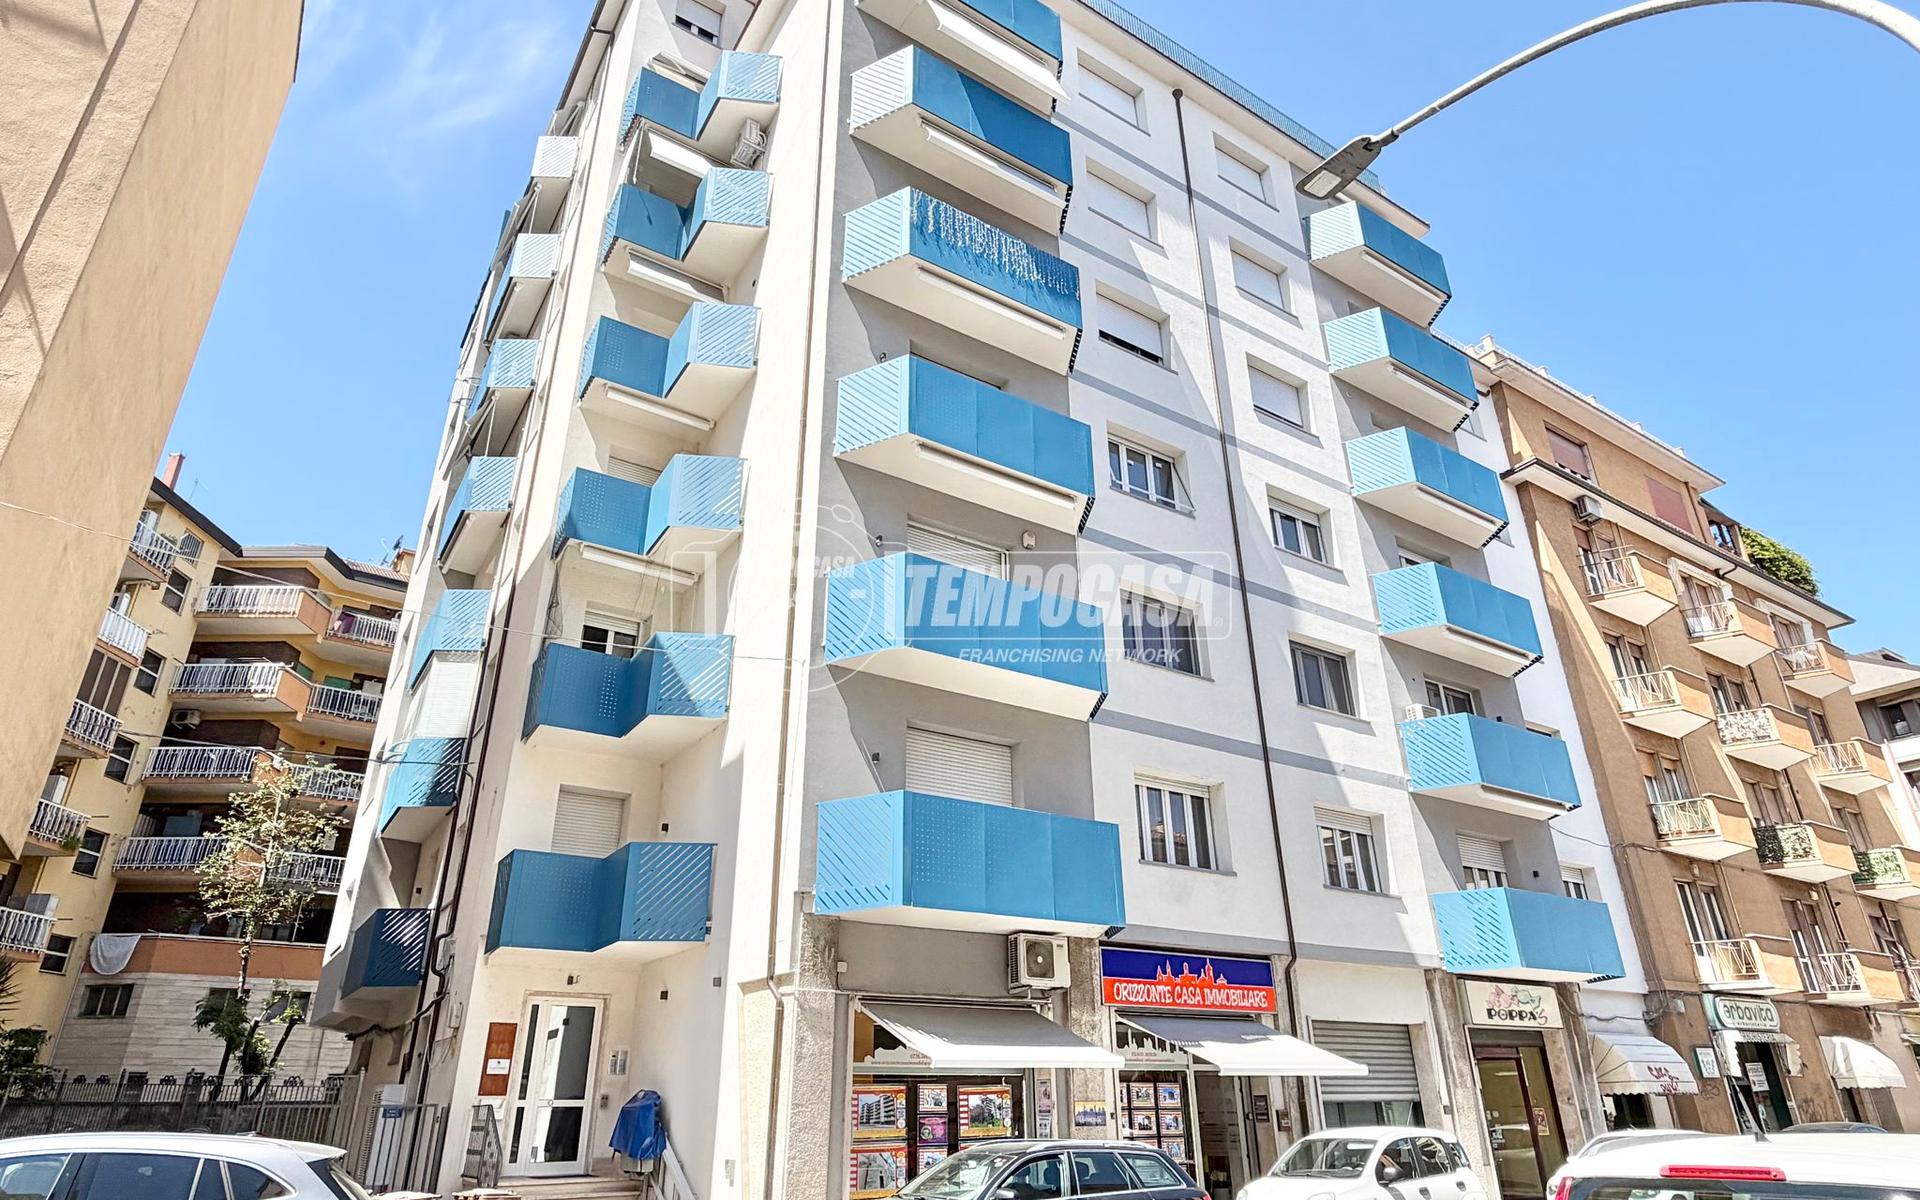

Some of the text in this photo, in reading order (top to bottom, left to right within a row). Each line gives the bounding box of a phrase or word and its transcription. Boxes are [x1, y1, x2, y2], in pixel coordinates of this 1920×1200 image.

[1113, 982, 1268, 1008] ORIZZONTE CASA IMMOBILIARE
